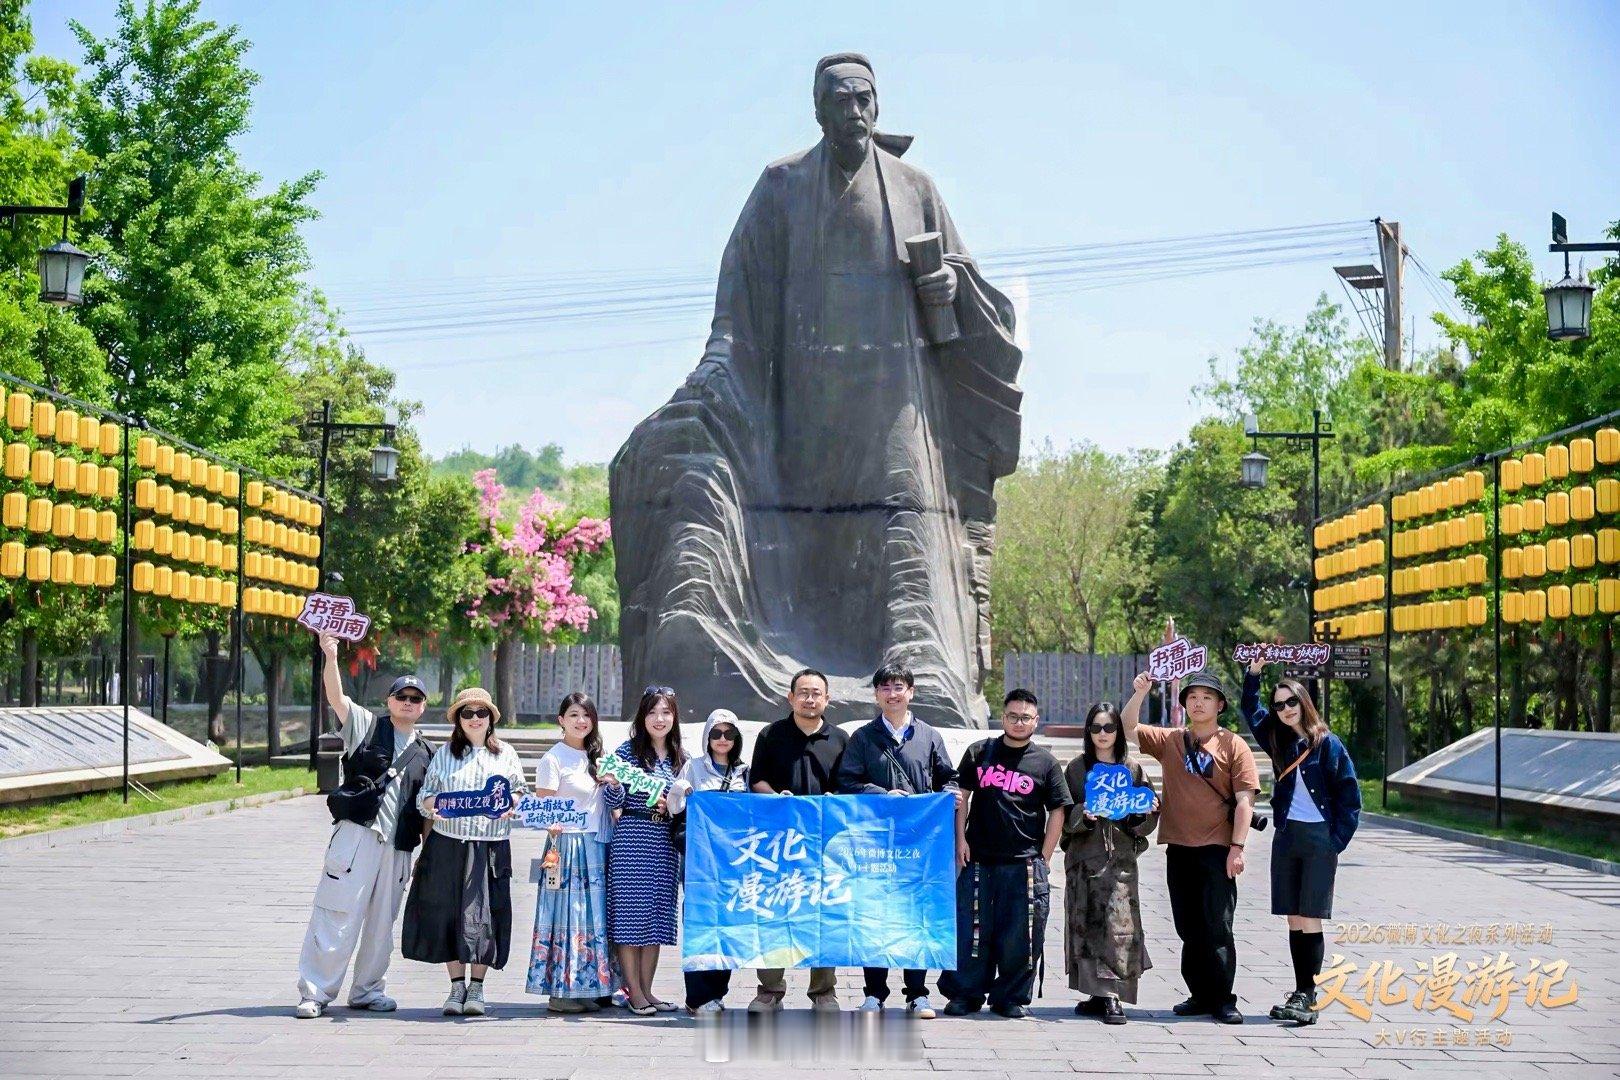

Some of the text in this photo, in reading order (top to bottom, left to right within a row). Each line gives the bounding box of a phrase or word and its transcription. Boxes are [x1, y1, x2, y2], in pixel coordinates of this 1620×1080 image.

[309, 597, 350, 617] 书香
[322, 615, 366, 637] 河南
[1152, 642, 1187, 668] 书香
[1169, 650, 1203, 676] 河南
[597, 753, 665, 807] 书香郑州
[1092, 771, 1128, 793] 文化
[518, 797, 576, 812] 在杜甫故里
[1091, 791, 1150, 816] 漫游记
[525, 811, 588, 826] 品读诗里山河
[729, 828, 807, 872] 文化
[725, 868, 853, 920] 漫游记
